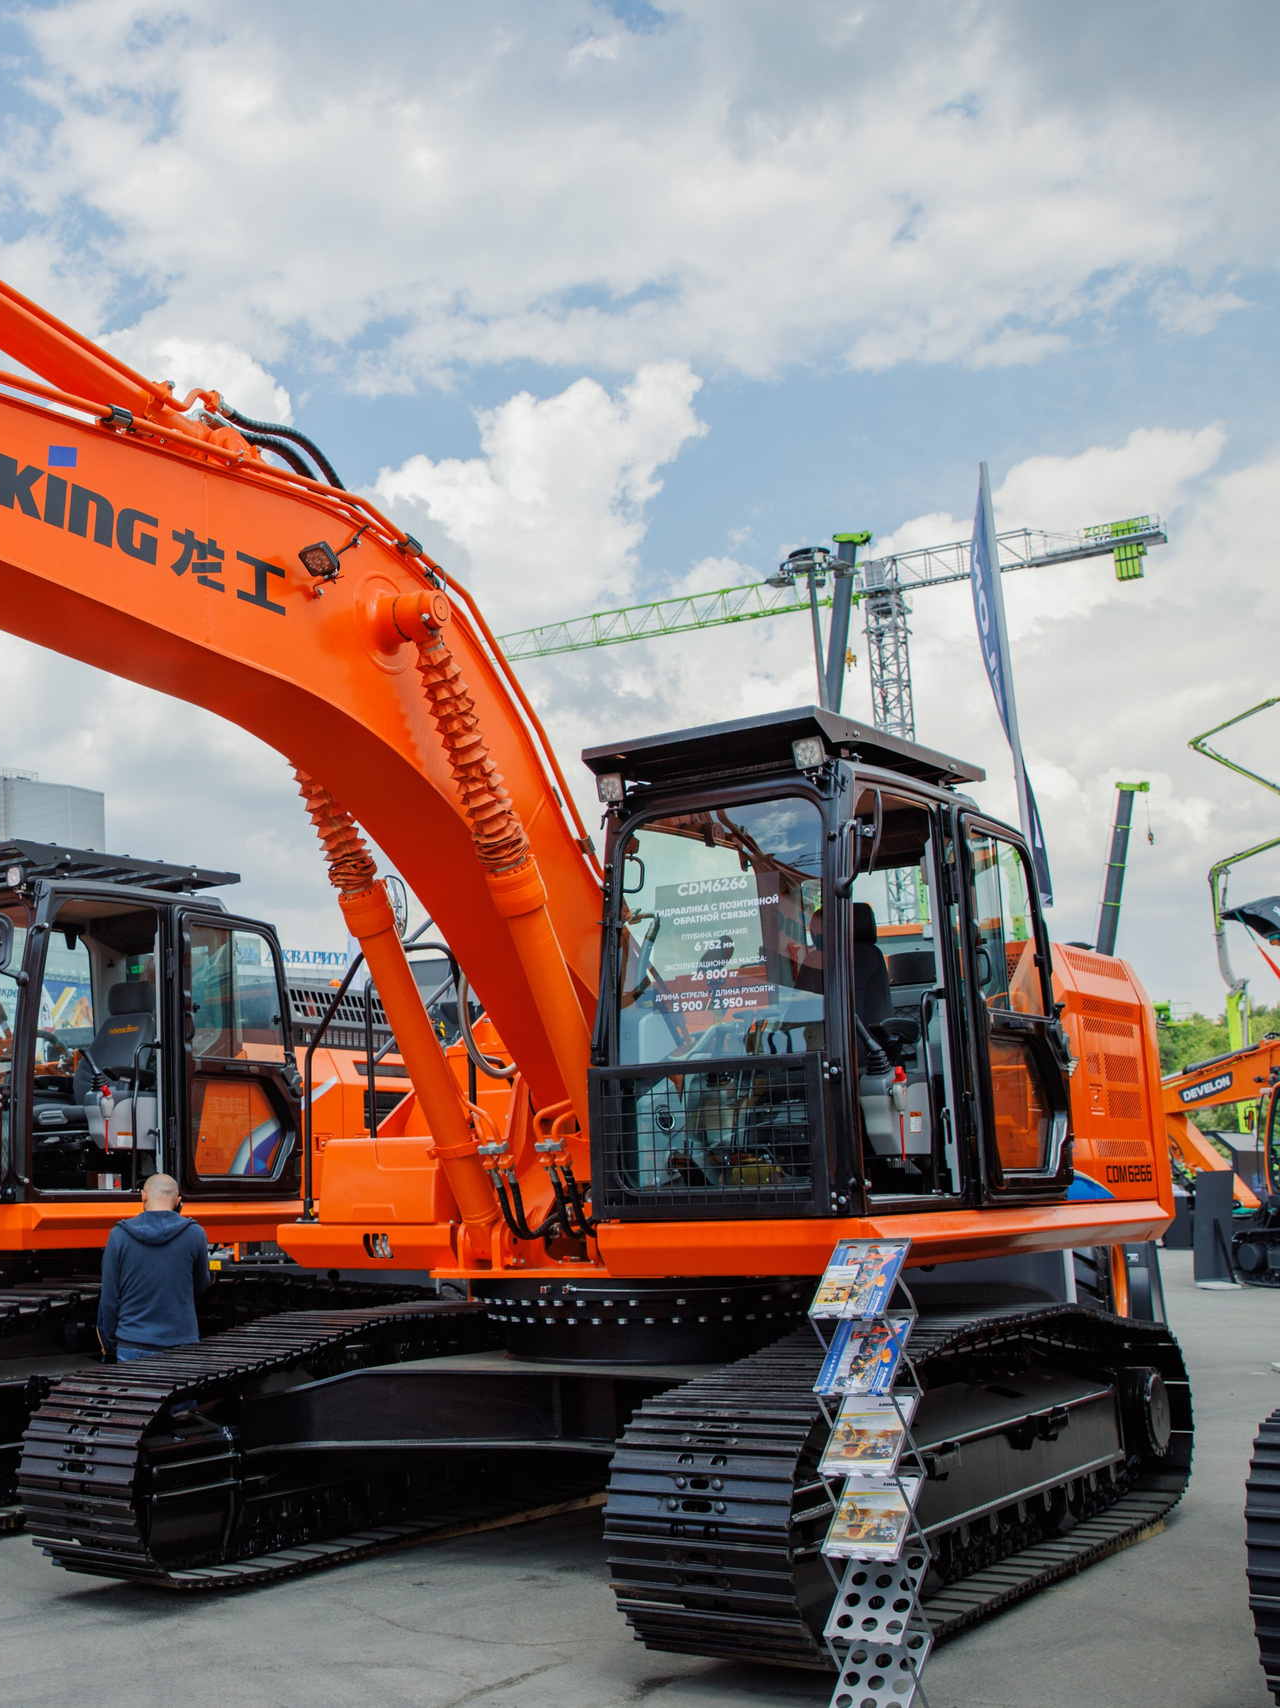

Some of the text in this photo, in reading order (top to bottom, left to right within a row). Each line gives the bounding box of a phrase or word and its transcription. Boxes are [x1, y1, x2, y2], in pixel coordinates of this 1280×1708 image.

[170, 528, 286, 616] 龙工
[678, 876, 748, 896] CDM6266
[654, 894, 779, 918] ГИДРАВЛИКА С ПОЗИТИВНОЙ
[673, 908, 758, 926] ОБРАТНОЙ СВЯЗЬЮ
[682, 927, 749, 941] ГЛУБИНА КОПАНИЯ:
[694, 942, 701, 951] 6
[704, 940, 722, 950] 752
[663, 955, 767, 972] ЭКСПЛУАТАЦИОННАЯ МАССА:
[690, 969, 739, 982] 26 800 кг
[655, 992, 680, 1003] ДЛИНА
[680, 990, 709, 1001] СТРЕЛЫ
[715, 988, 740, 998] ДЛИНА
[741, 985, 776, 995] РУКОЯТИ:
[672, 1003, 680, 1013] 5
[682, 1000, 703, 1011] 900
[713, 998, 721, 1009] 2
[722, 997, 744, 1008] 950
[1183, 1076, 1231, 1102] DEVELON
[1106, 1164, 1152, 1183] CDM6266
